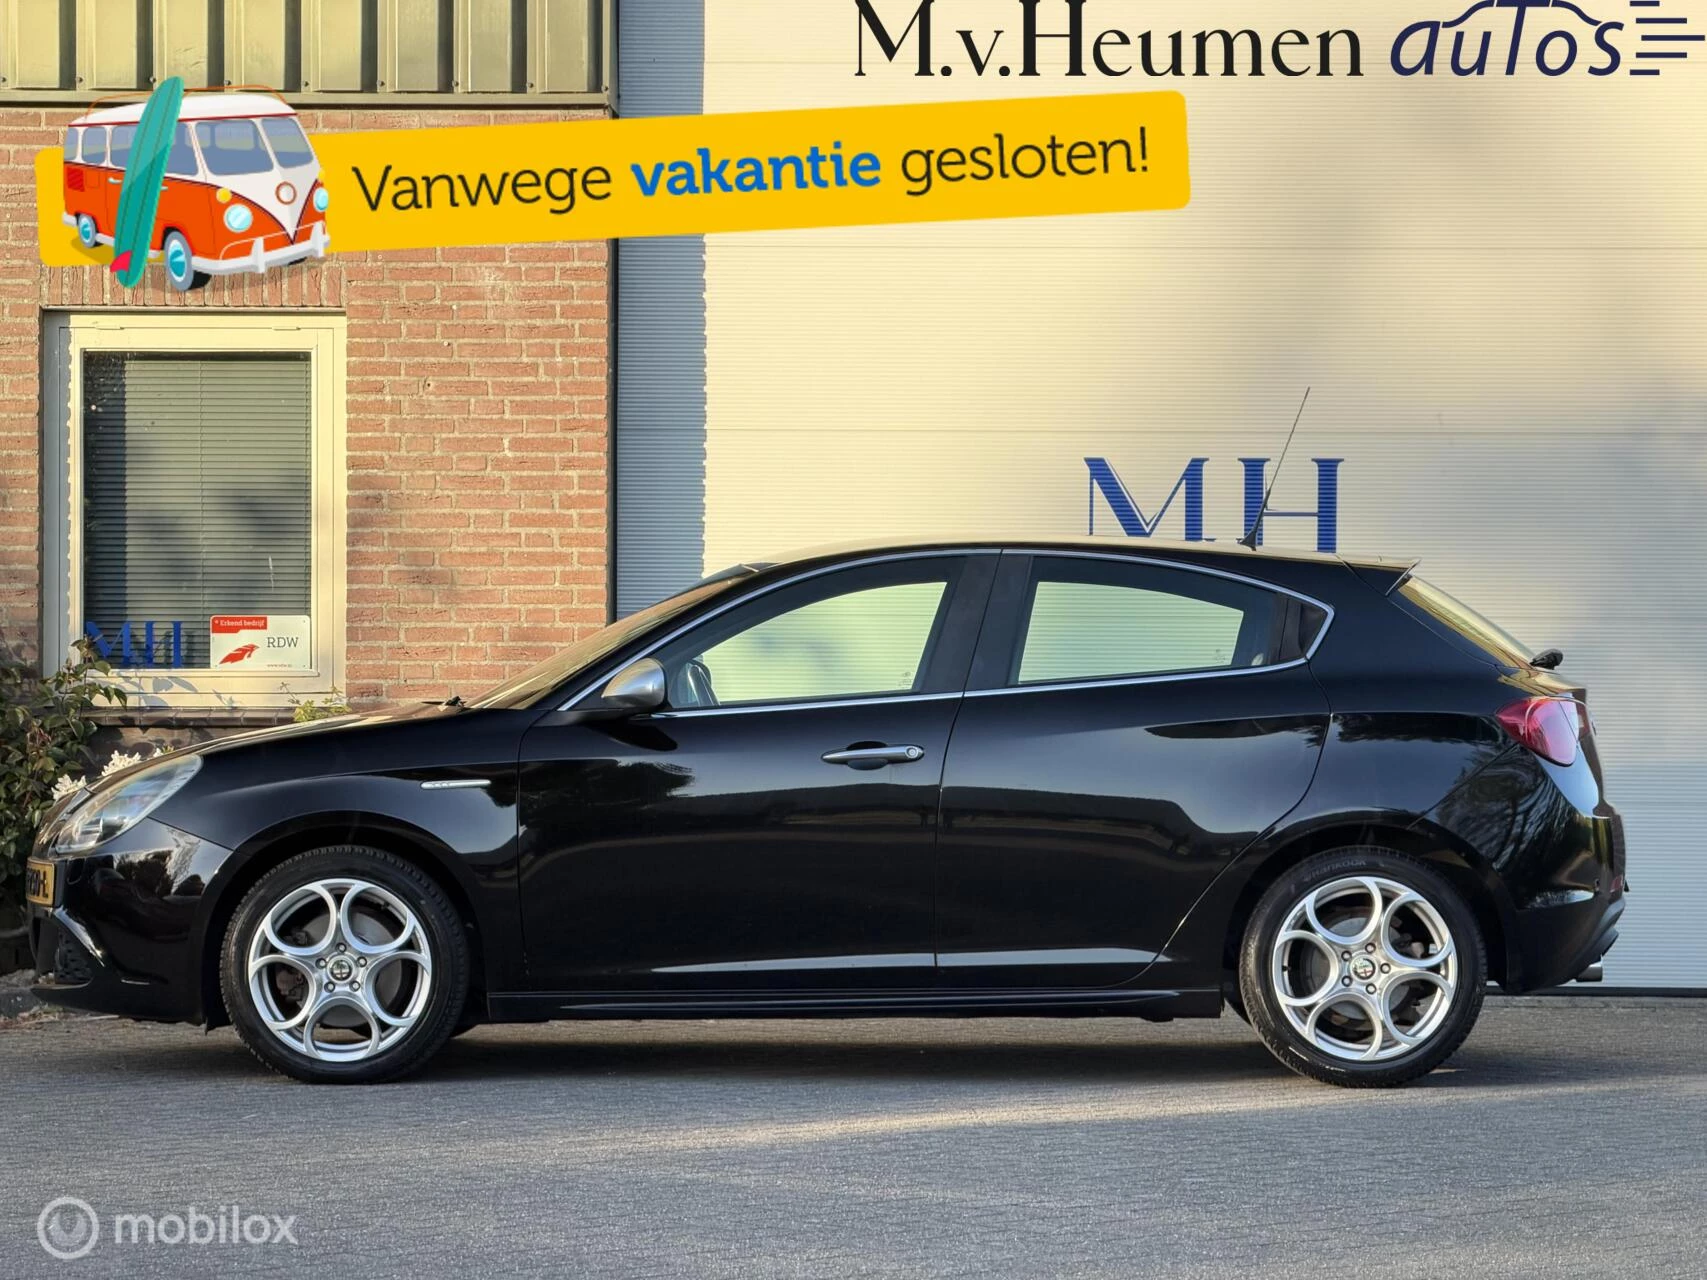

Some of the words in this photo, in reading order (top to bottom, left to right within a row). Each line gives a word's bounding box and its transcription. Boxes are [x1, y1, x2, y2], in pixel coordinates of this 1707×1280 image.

[1083, 457, 1345, 553] MH
[220, 619, 243, 627] Erkend
[244, 619, 265, 628] bedrijf
[266, 636, 299, 648] RDW
